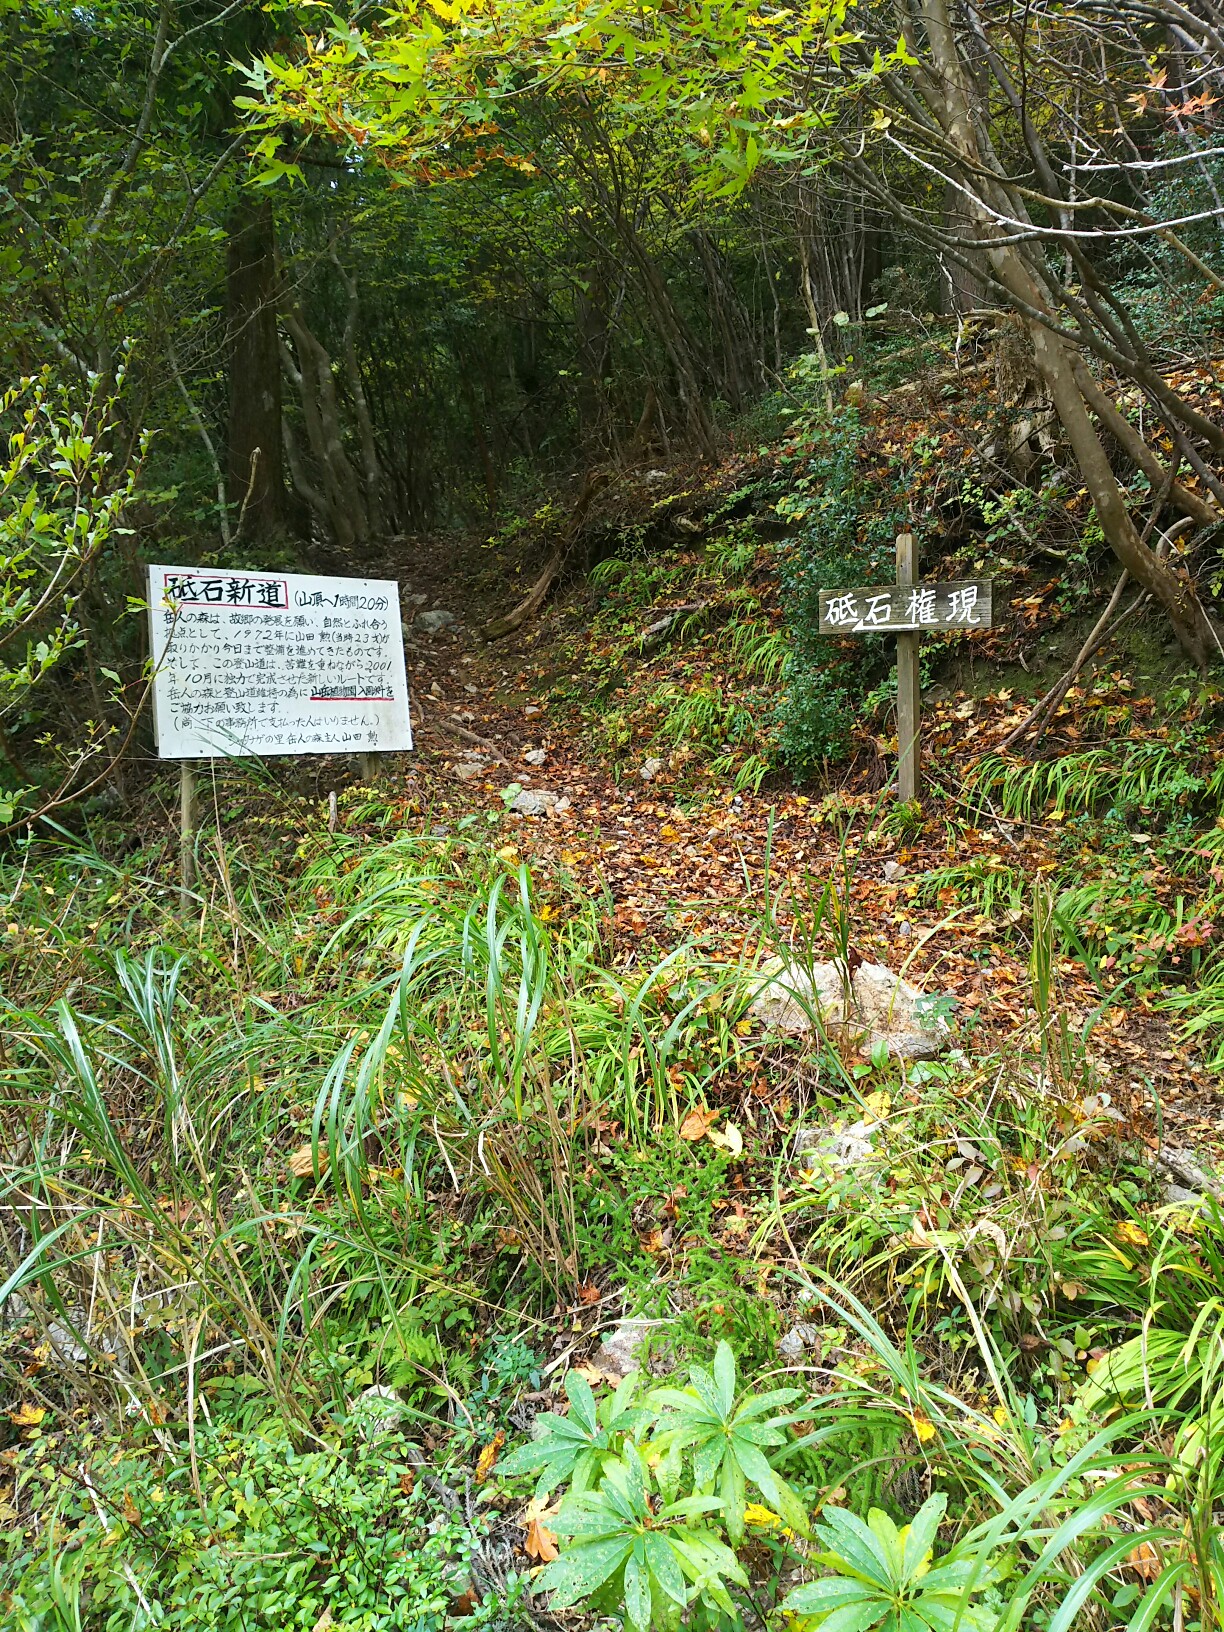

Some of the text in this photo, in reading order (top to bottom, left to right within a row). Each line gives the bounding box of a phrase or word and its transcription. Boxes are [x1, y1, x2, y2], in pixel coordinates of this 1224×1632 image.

[168, 576, 286, 608] 砥石新道
[824, 585, 981, 625] 砥石権現
